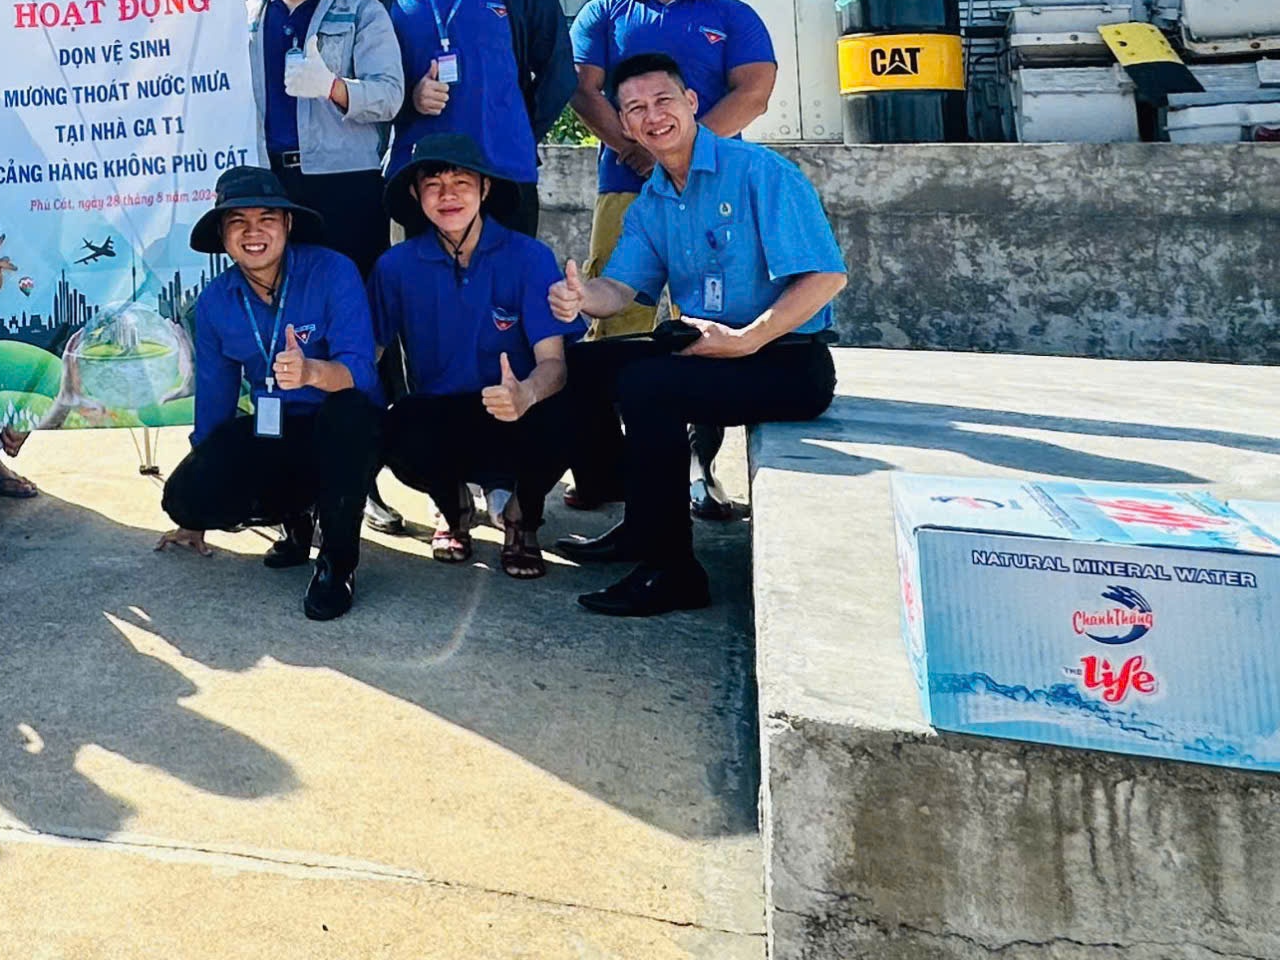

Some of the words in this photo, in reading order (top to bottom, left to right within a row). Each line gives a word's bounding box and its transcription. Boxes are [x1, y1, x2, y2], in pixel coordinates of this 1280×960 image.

[13, 0, 106, 32] HOẠT
[59, 46, 96, 69] DỌN
[101, 39, 123, 66] VỆ
[129, 38, 170, 60] SINH
[871, 47, 921, 76] CAT
[4, 85, 67, 108] MƯƠNG
[72, 79, 130, 104] THOÁT
[137, 73, 185, 99] NƯỚC
[191, 69, 230, 94] MƯA
[55, 124, 85, 146] TẠI
[91, 116, 127, 141] NHÀ
[133, 118, 157, 137] GA
[162, 116, 184, 135] T1
[48, 157, 98, 182] HÀNG
[103, 152, 166, 178] KHÔNG
[172, 147, 208, 174] PHÙ
[214, 144, 248, 170] CÁT
[106, 189, 120, 207] 28
[971, 550, 1069, 573] NATURAL
[1073, 558, 1171, 581] MINERAL
[1173, 566, 1257, 588] WATER
